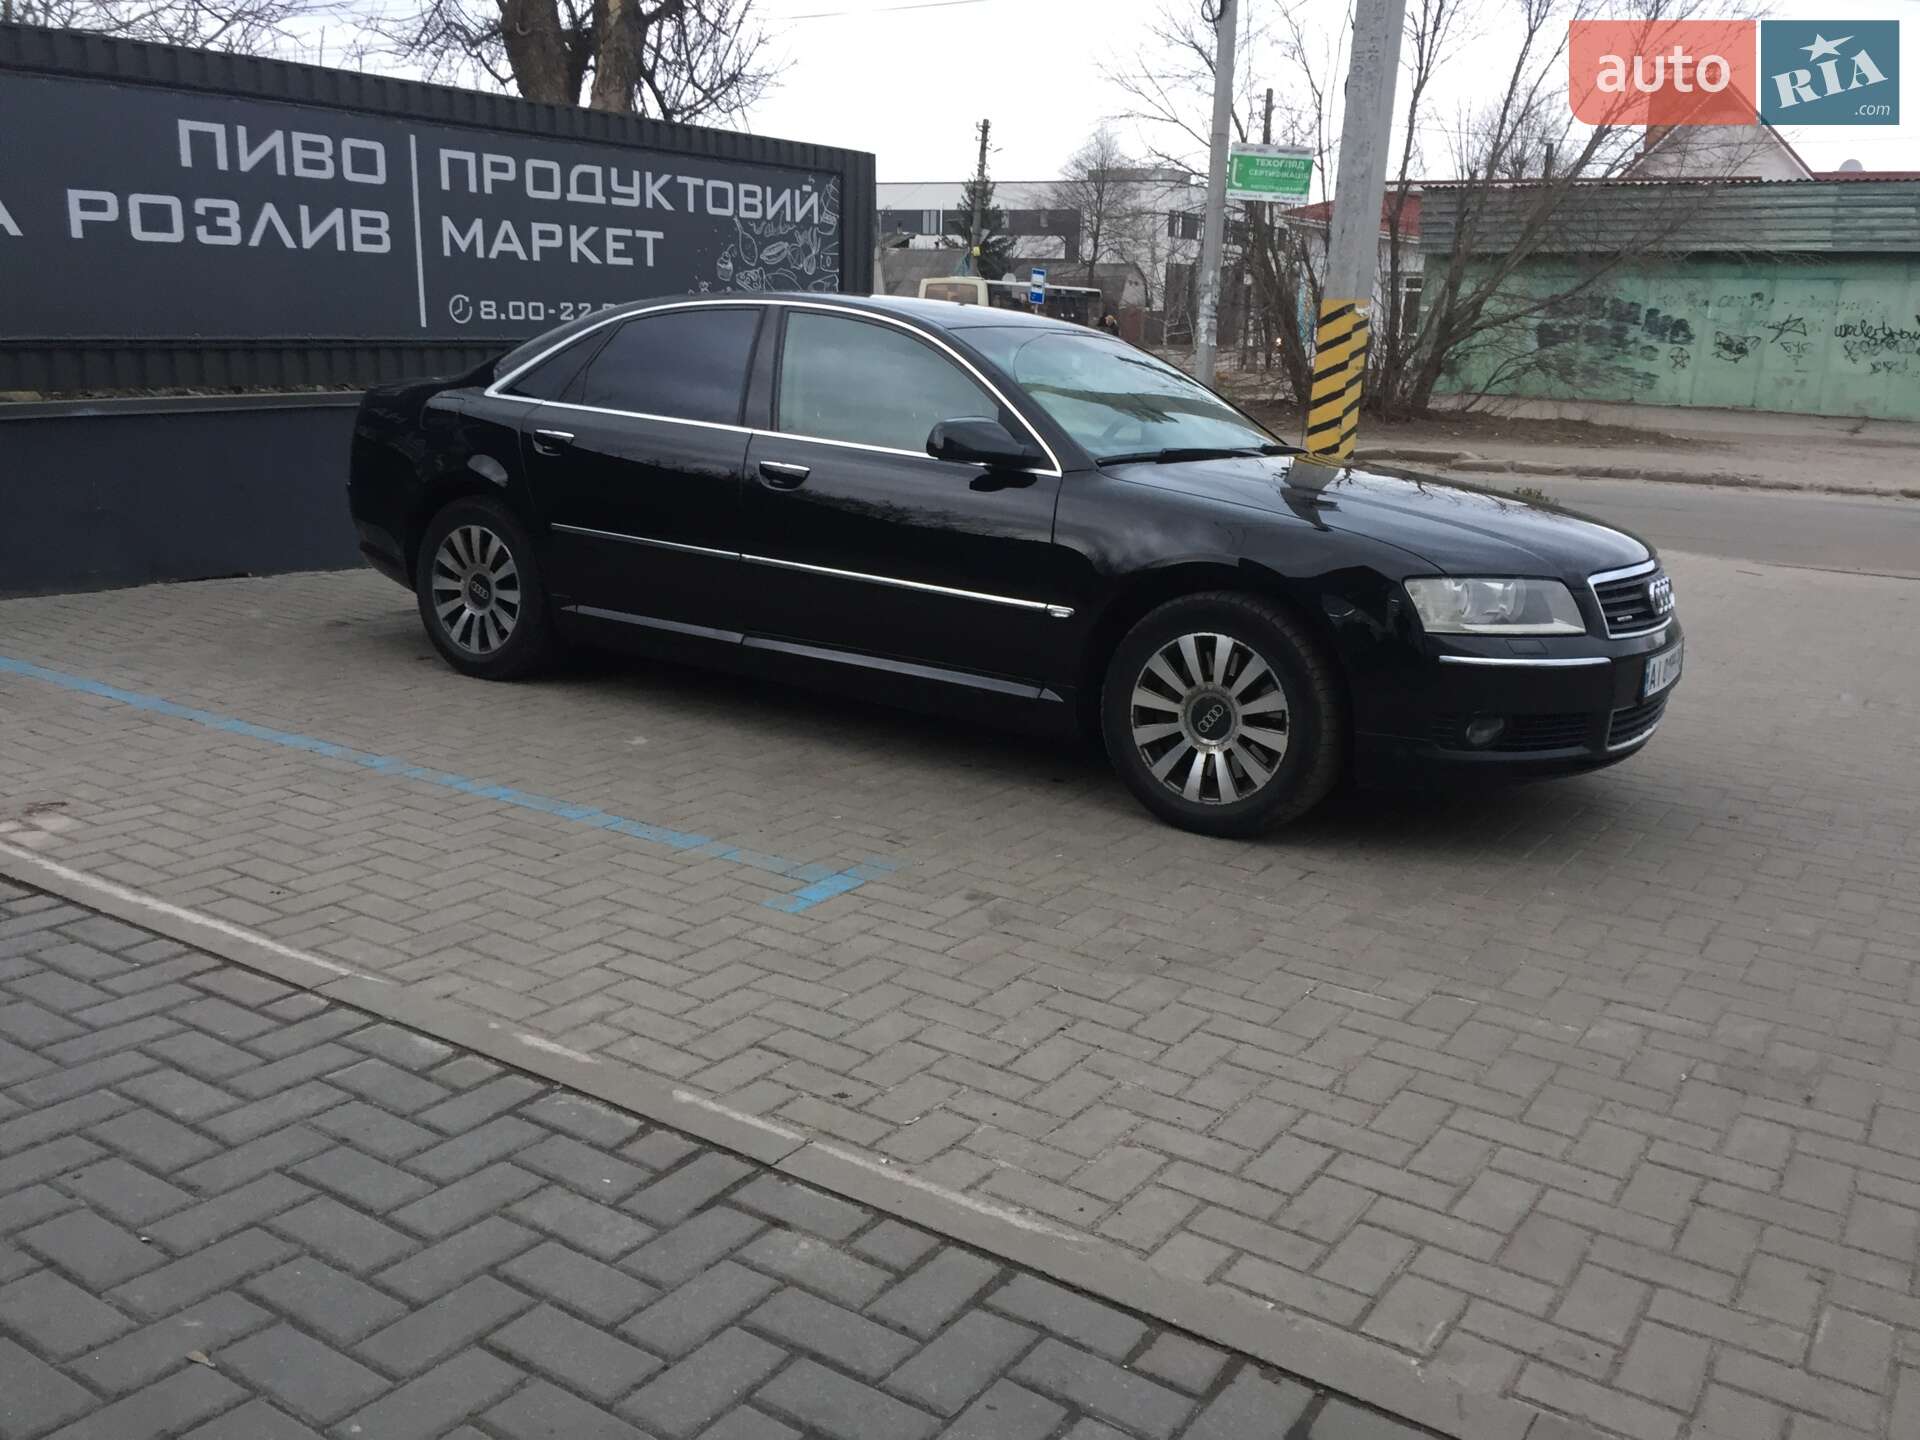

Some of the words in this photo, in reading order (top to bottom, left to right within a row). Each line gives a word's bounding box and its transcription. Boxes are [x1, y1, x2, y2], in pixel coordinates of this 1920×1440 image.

[178, 119, 387, 185] ПИВО
[440, 148, 819, 224] ПРОДУКТОВИЙ
[67, 189, 391, 254] РОЗЛИВ
[442, 216, 664, 267] МАРКЕТ
